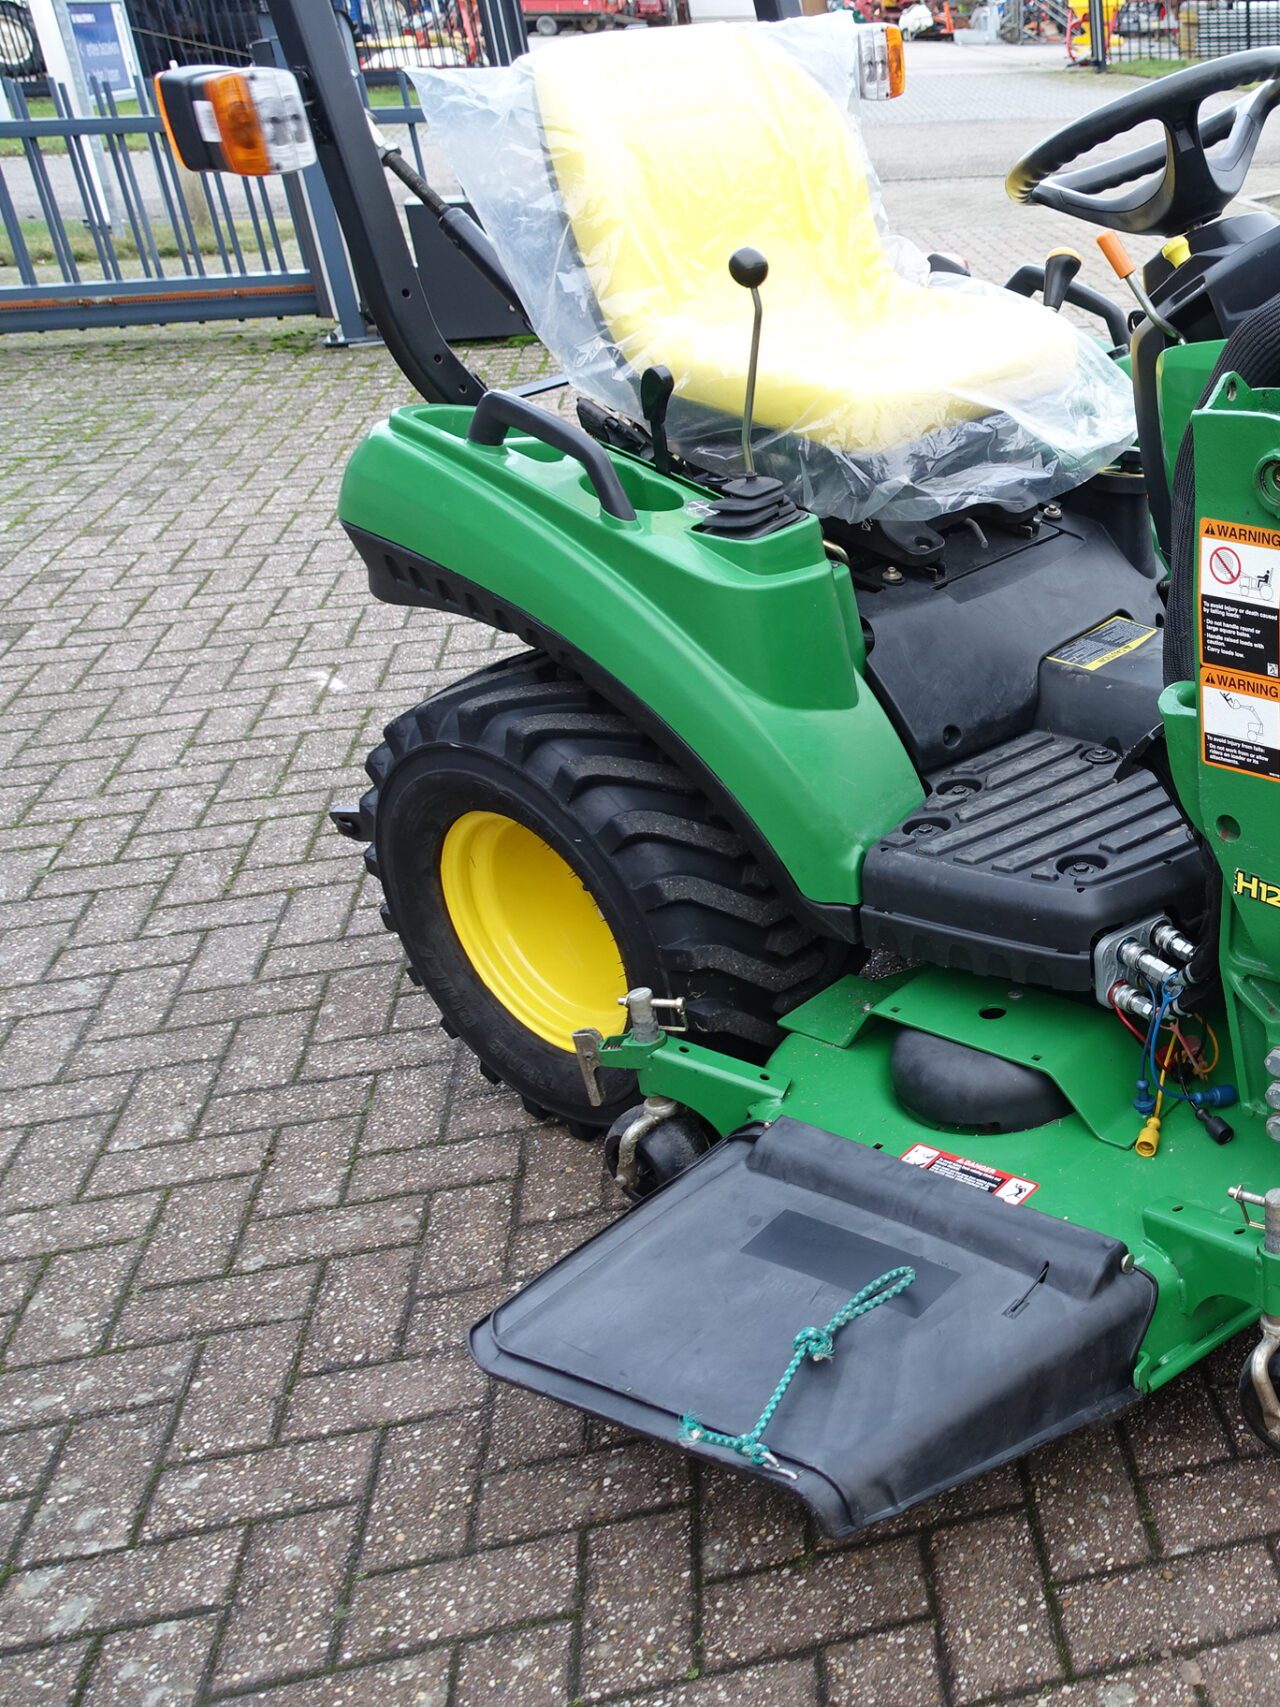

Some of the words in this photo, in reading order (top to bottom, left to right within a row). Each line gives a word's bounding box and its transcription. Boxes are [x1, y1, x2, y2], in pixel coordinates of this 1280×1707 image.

[1217, 524, 1280, 547] WARNING
[1217, 674, 1279, 698] WARNING
[963, 1159, 997, 1174] DANGER
